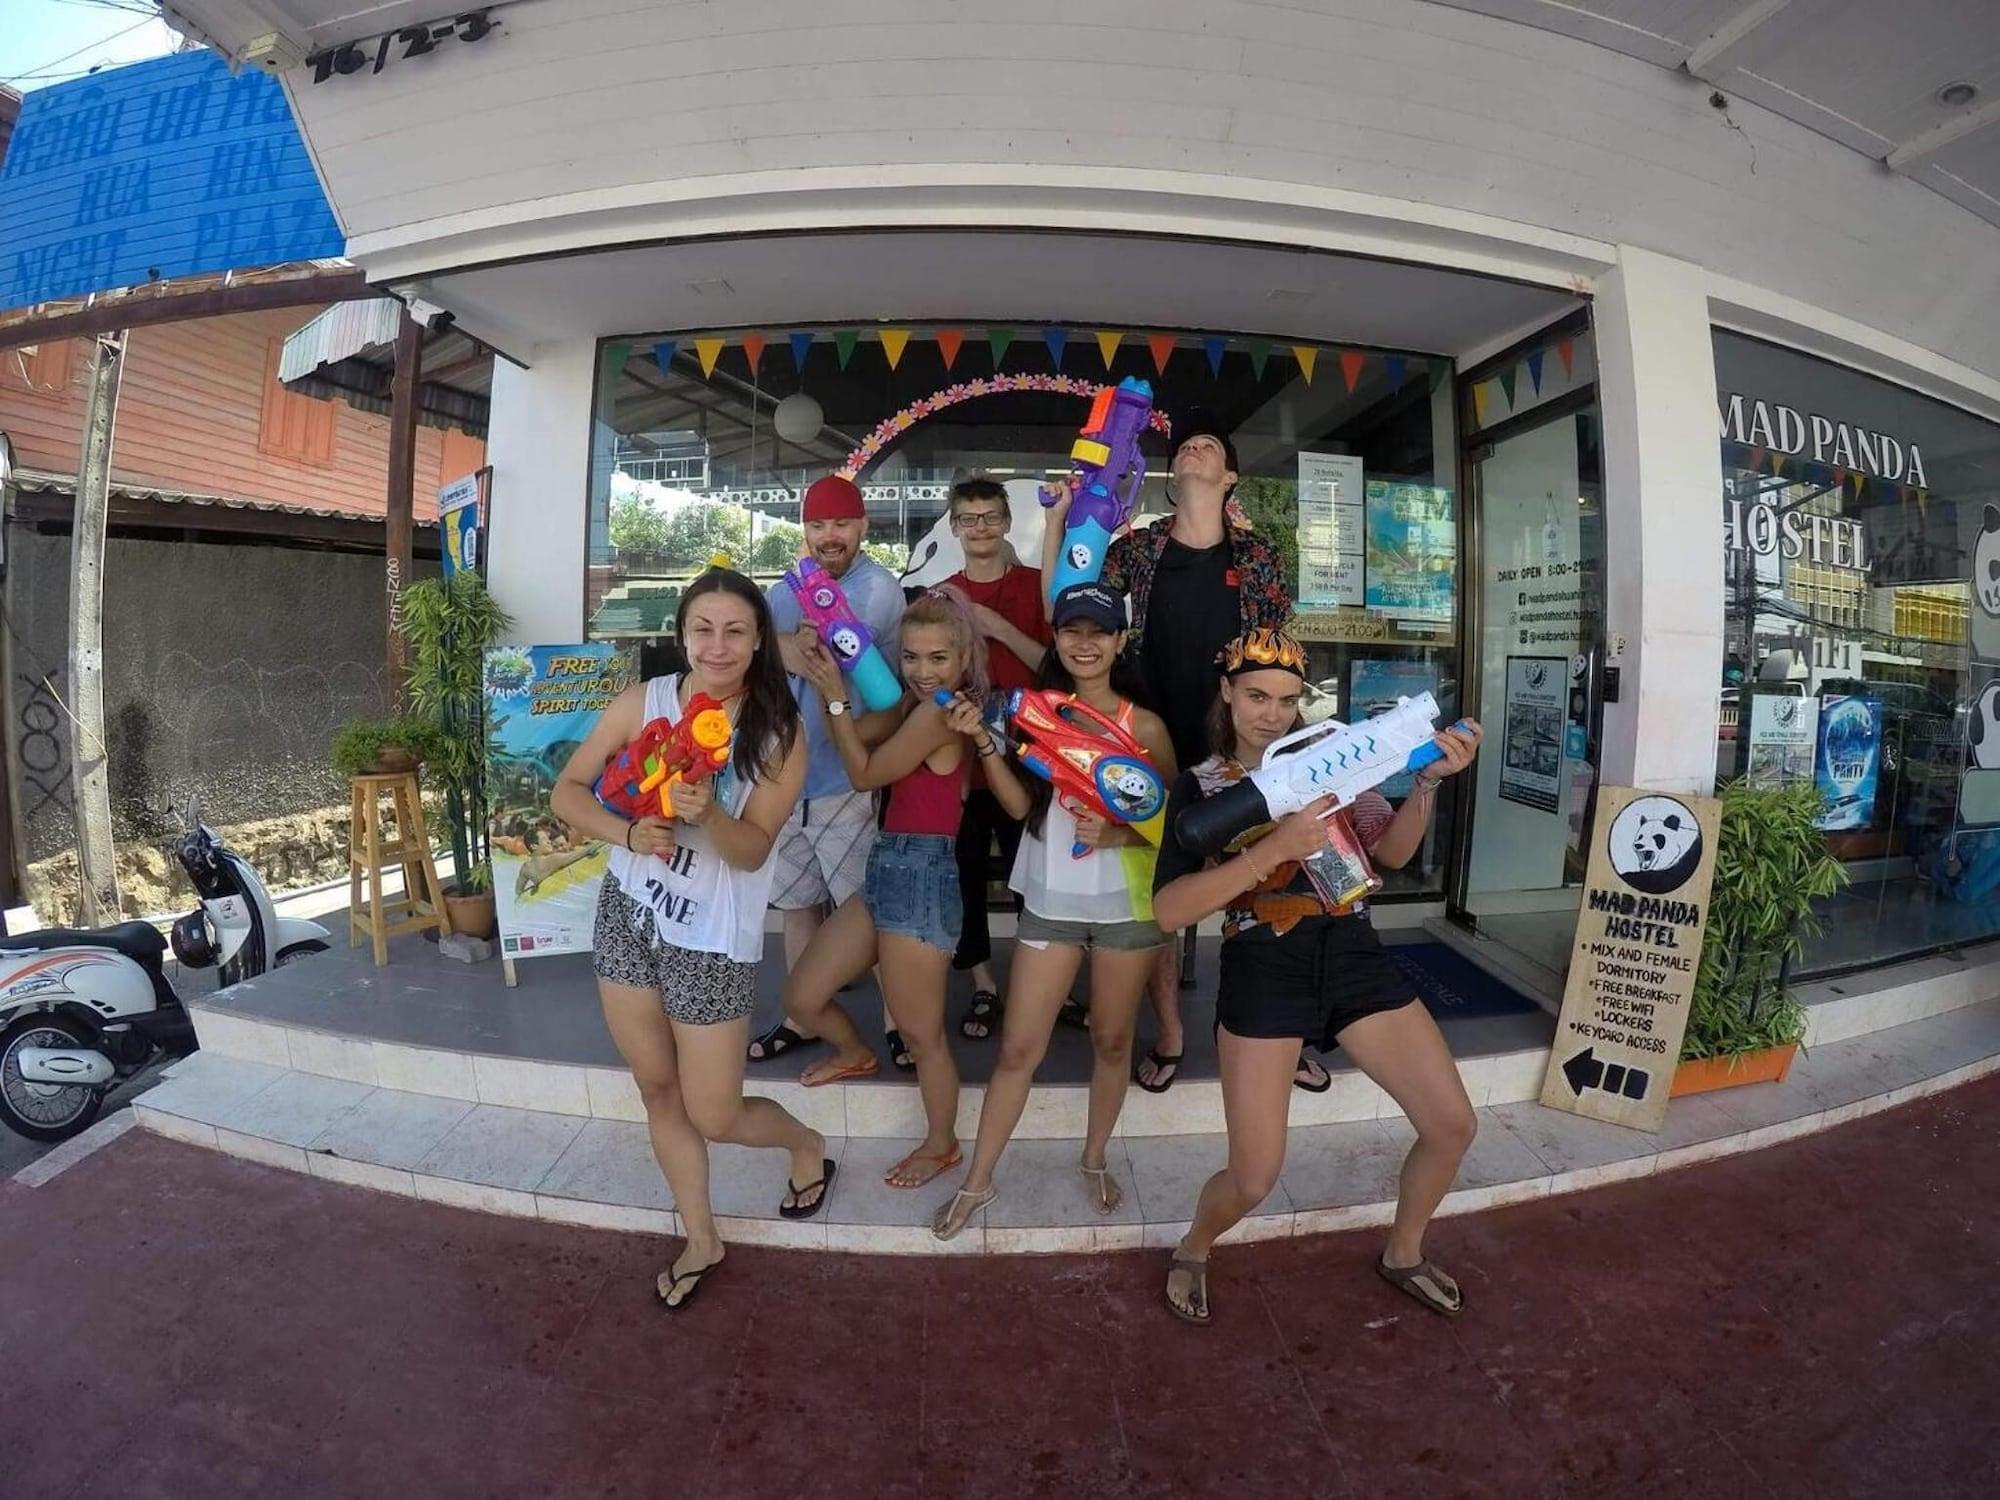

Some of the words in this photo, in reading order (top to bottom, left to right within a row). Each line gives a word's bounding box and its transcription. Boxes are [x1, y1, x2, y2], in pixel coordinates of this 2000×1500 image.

[305, 7, 502, 84] 76/2-3
[75, 158, 153, 227] HUA
[206, 134, 290, 202] HIN
[1719, 394, 1806, 456] MAD
[1809, 414, 1929, 490] PANDA
[1723, 498, 1874, 573] HOSTEL
[1497, 571, 1517, 583] DAILY
[1520, 566, 1542, 580] OPEN
[546, 655, 601, 679] FREE
[531, 698, 581, 716] SPIRIT
[581, 699, 613, 713] TOGE
[665, 843, 699, 880] HE
[1588, 888, 1638, 918] MAD
[1637, 894, 1701, 929] PANDA
[1604, 916, 1679, 948] HOSTEL
[1590, 944, 1615, 962] MIX
[1617, 947, 1643, 964] AND
[1645, 950, 1692, 973] FEMALE
[1596, 960, 1667, 986] DORMITORY
[1594, 979, 1623, 997] FREE
[1624, 982, 1682, 1006] BREAKFAST
[1601, 996, 1631, 1013] FREE
[1631, 1000, 1655, 1018] WIFI
[1600, 1012, 1654, 1033] LOCKERS
[1575, 1021, 1625, 1044] KEYCARD
[1625, 1032, 1667, 1055] ACCESS
